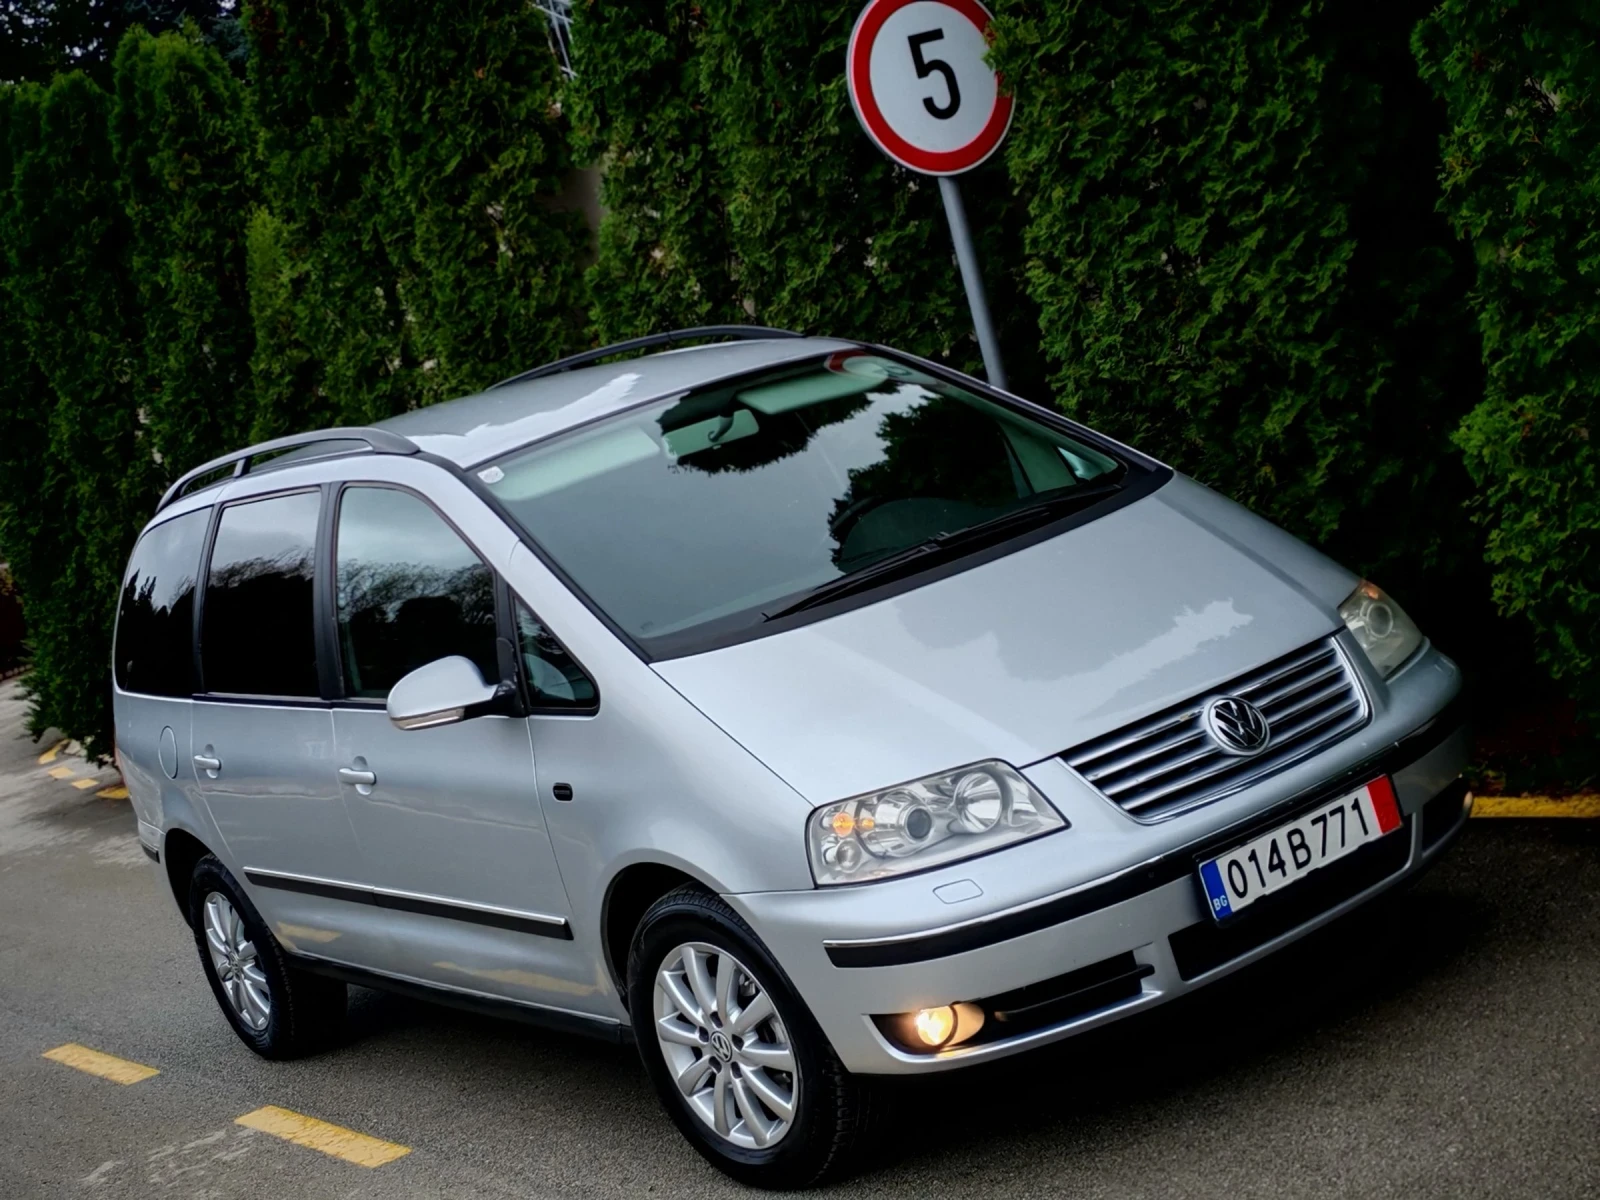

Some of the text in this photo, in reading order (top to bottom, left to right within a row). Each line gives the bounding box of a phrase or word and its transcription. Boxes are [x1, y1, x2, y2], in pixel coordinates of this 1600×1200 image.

[907, 28, 961, 120] 5
[1208, 698, 1267, 752] VW
[1227, 797, 1369, 899] 014B771
[1212, 895, 1228, 911] BG
